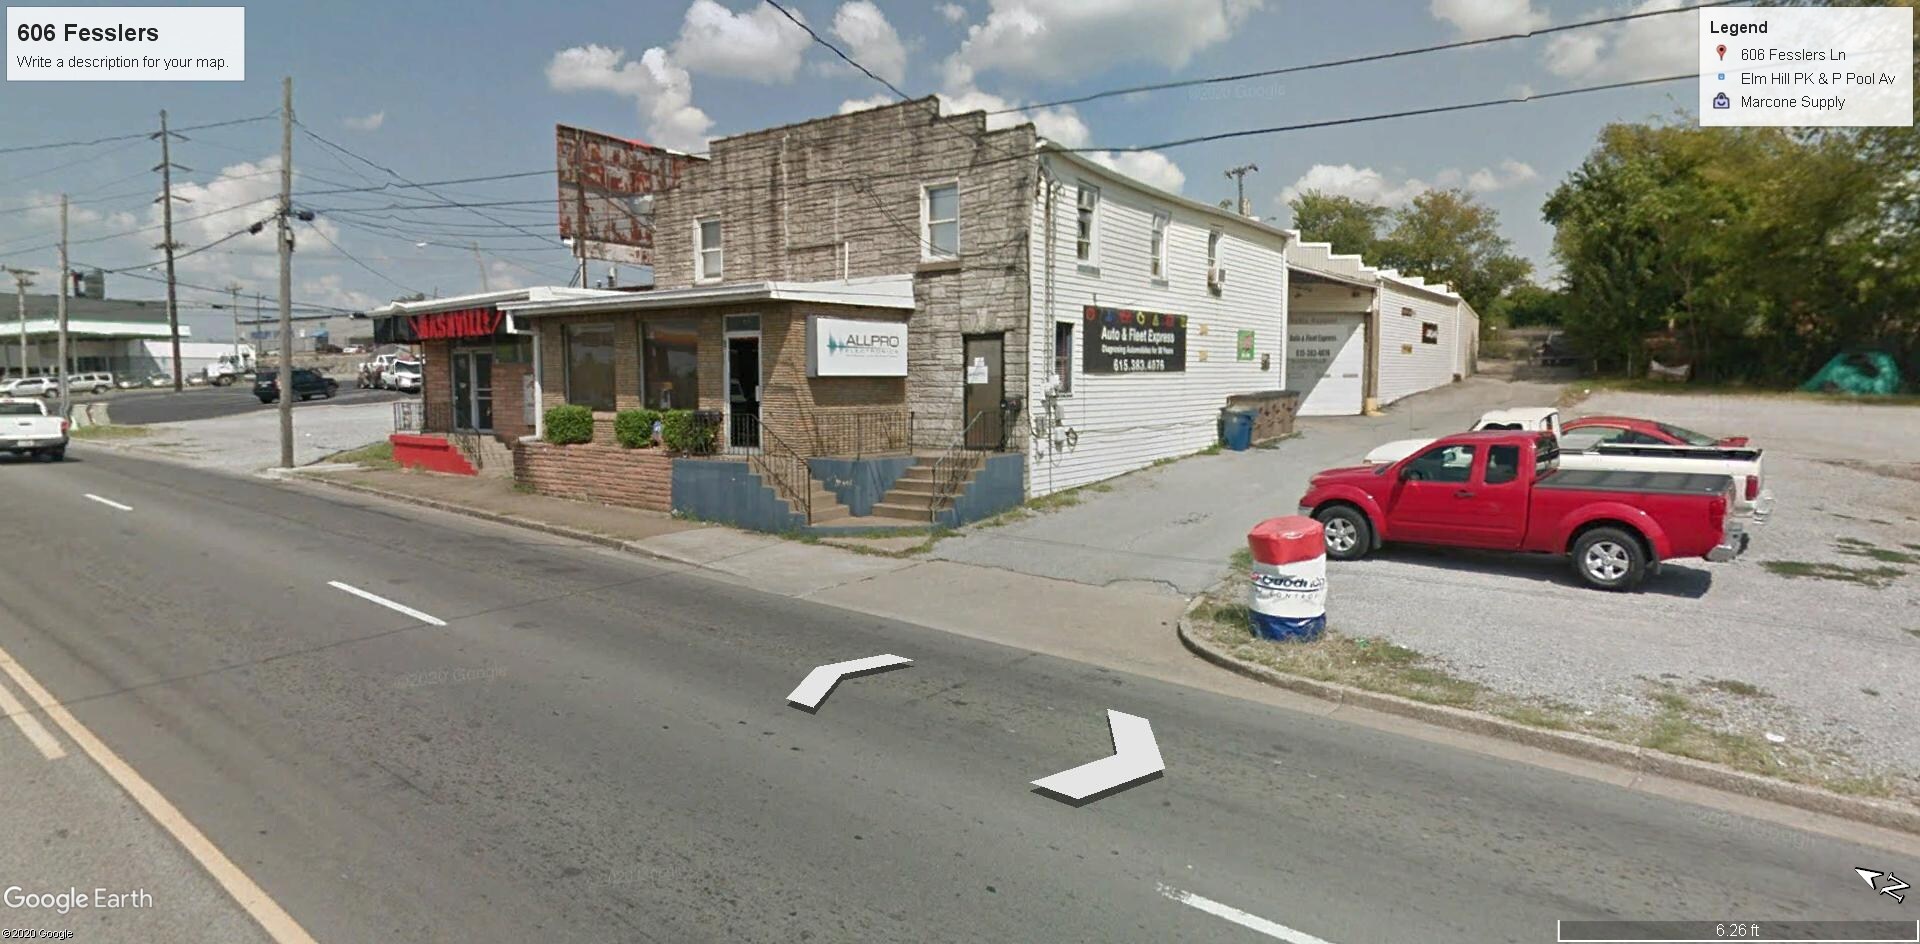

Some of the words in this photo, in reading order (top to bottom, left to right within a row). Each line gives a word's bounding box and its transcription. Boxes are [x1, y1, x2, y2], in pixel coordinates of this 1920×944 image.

[846, 333, 900, 348] ALLPRO
[1101, 326, 1120, 341] Auto
[1121, 327, 1127, 341] &
[1128, 328, 1147, 342] Fleet
[1148, 328, 1175, 345] Express
